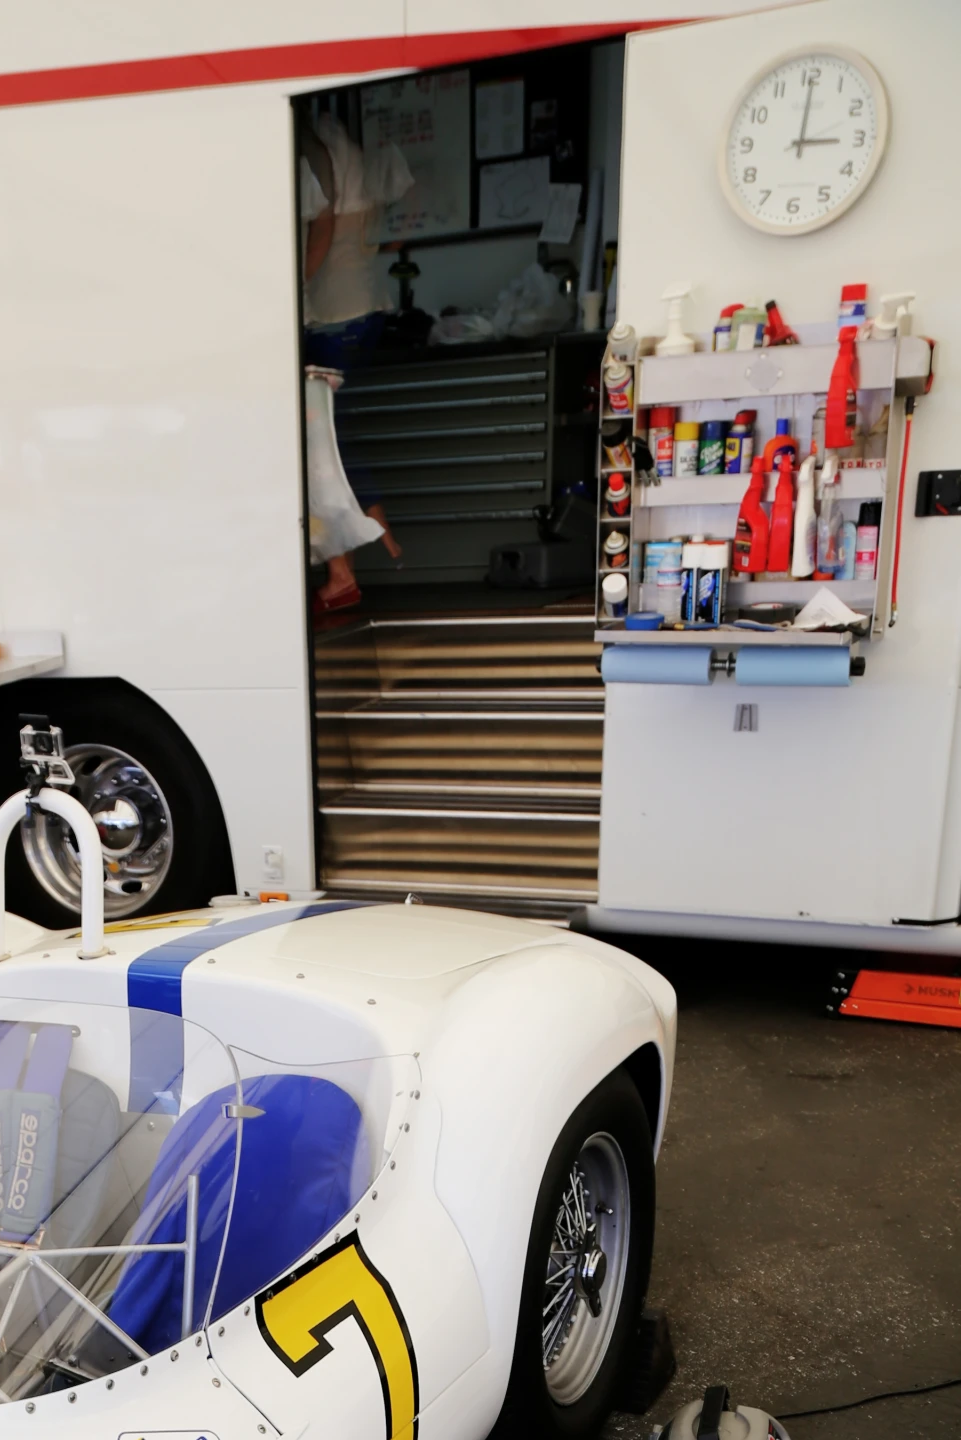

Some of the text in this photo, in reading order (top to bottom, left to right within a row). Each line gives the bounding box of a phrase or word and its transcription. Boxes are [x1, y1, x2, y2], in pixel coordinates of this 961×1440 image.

[800, 68, 821, 87] 12
[838, 75, 844, 93] 1
[774, 80, 786, 99] 11
[750, 105, 768, 124] 10
[848, 99, 864, 117] 2
[740, 136, 754, 154] 9
[852, 129, 866, 148] 3
[742, 166, 757, 183] 8
[839, 160, 853, 178] 4
[758, 189, 772, 206] 7
[817, 185, 831, 203] 5
[786, 197, 800, 214] 6
